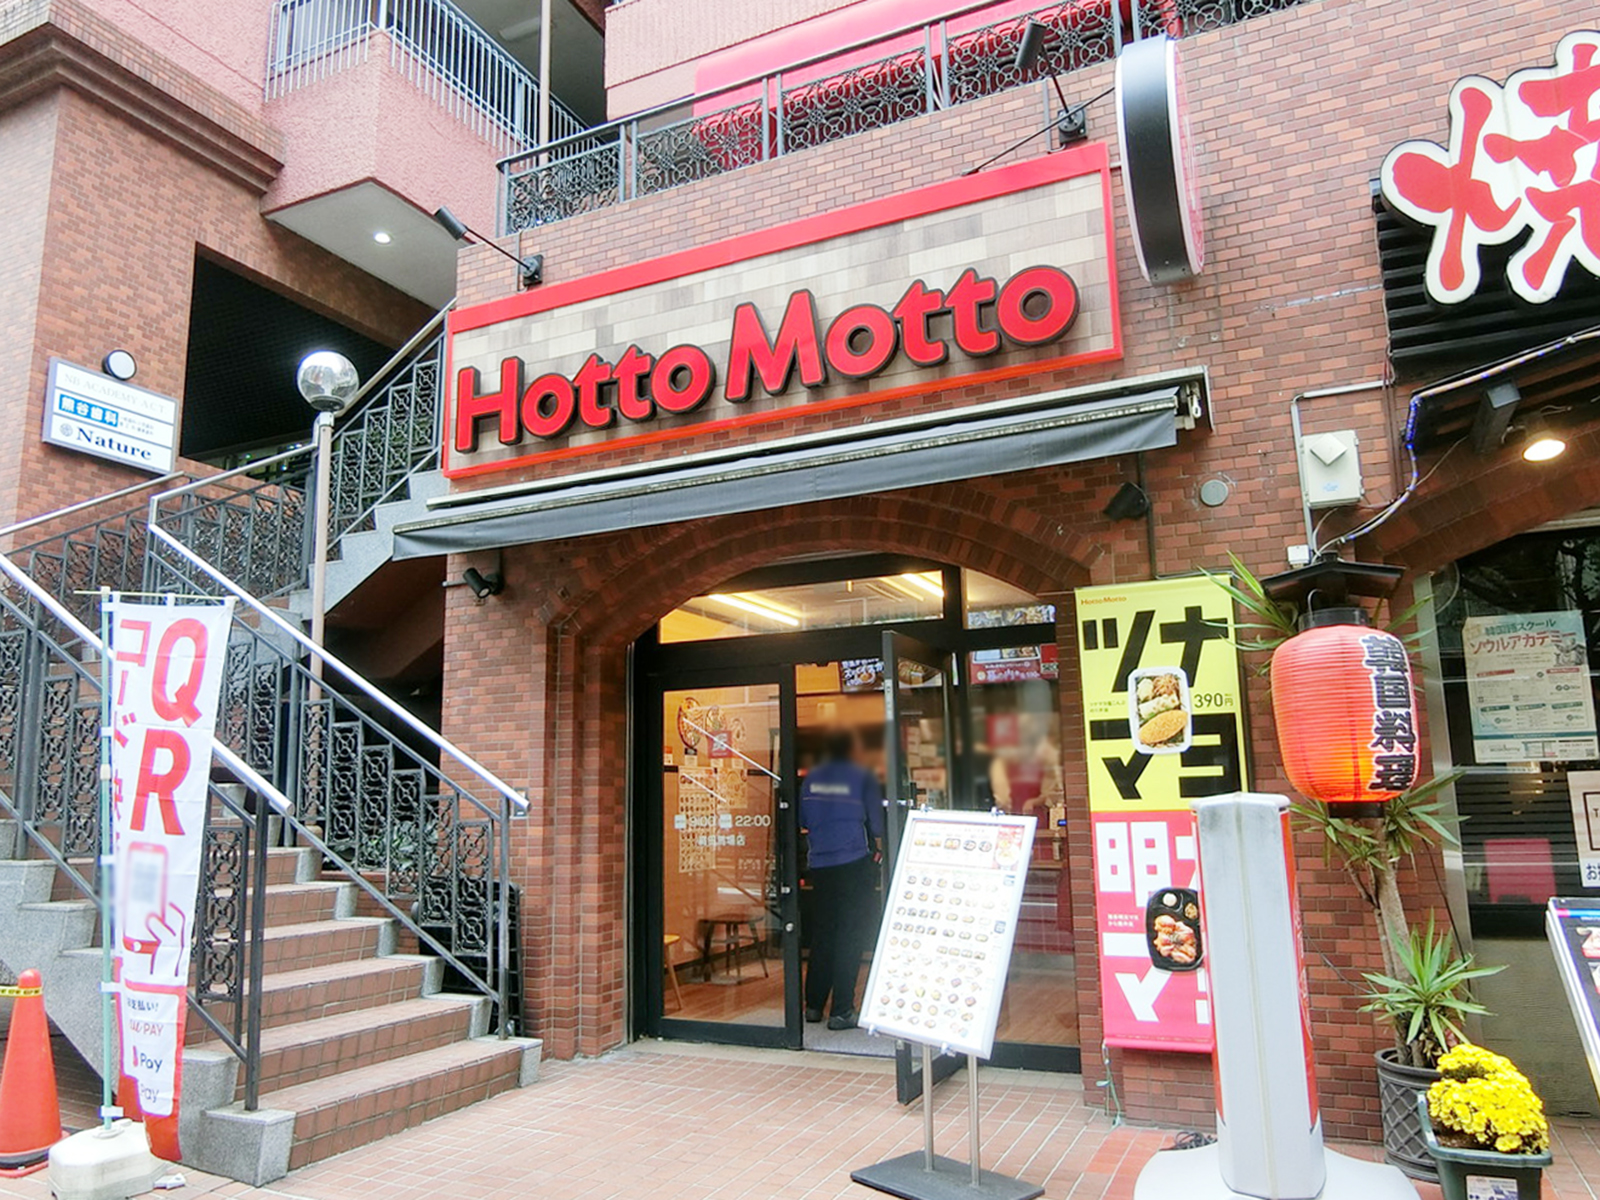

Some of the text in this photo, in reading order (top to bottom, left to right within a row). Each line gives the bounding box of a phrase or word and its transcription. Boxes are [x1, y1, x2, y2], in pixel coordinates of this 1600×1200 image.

[456, 265, 1079, 452] Hotto Motto
[83, 380, 139, 405] ACADEMY
[76, 427, 152, 460] Nature
[1470, 630, 1576, 654] ソウルアカデミー
[1194, 692, 1234, 709] 390円
[130, 618, 208, 835] QR
[735, 814, 771, 827] 22:00
